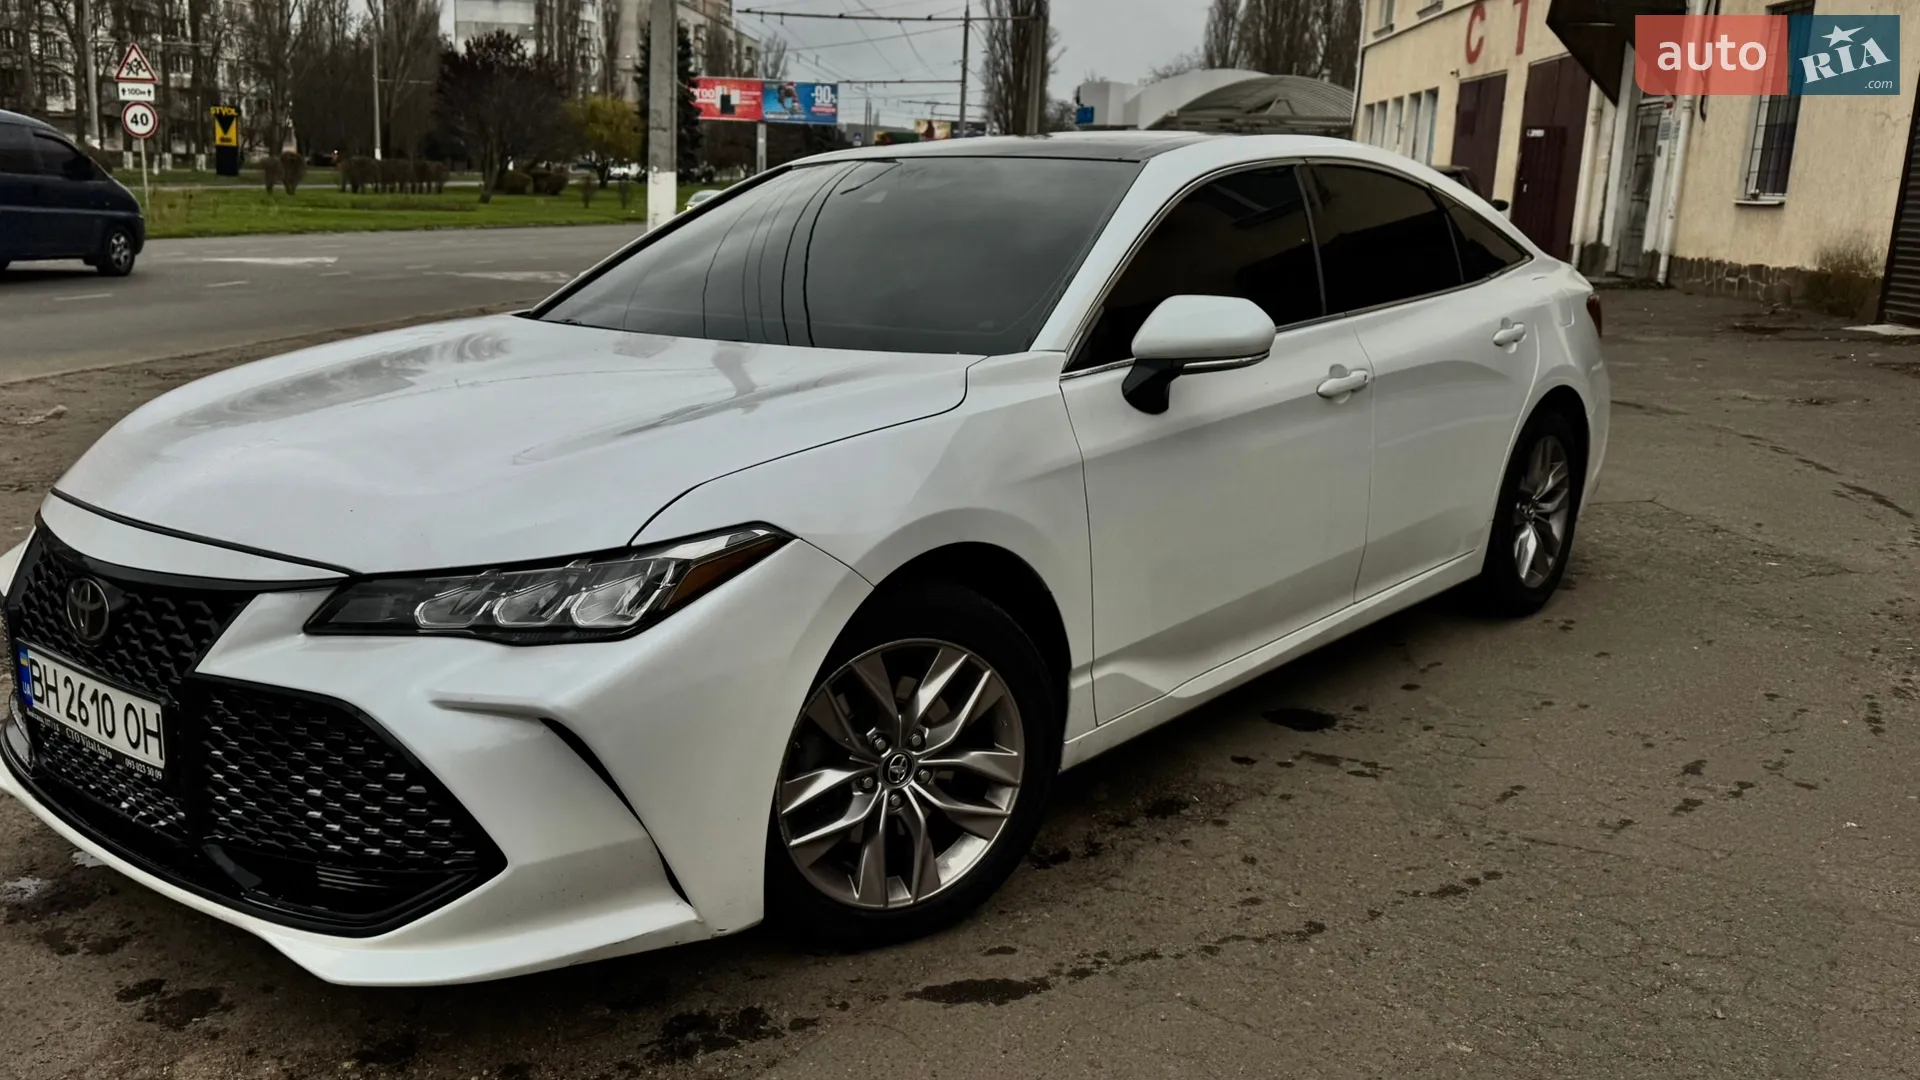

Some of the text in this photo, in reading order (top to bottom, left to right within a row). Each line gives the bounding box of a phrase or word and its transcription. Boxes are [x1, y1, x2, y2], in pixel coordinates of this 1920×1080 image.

[130, 112, 149, 126] 40
[29, 657, 60, 713] BH
[64, 675, 116, 739] 2610
[124, 702, 164, 760] OH
